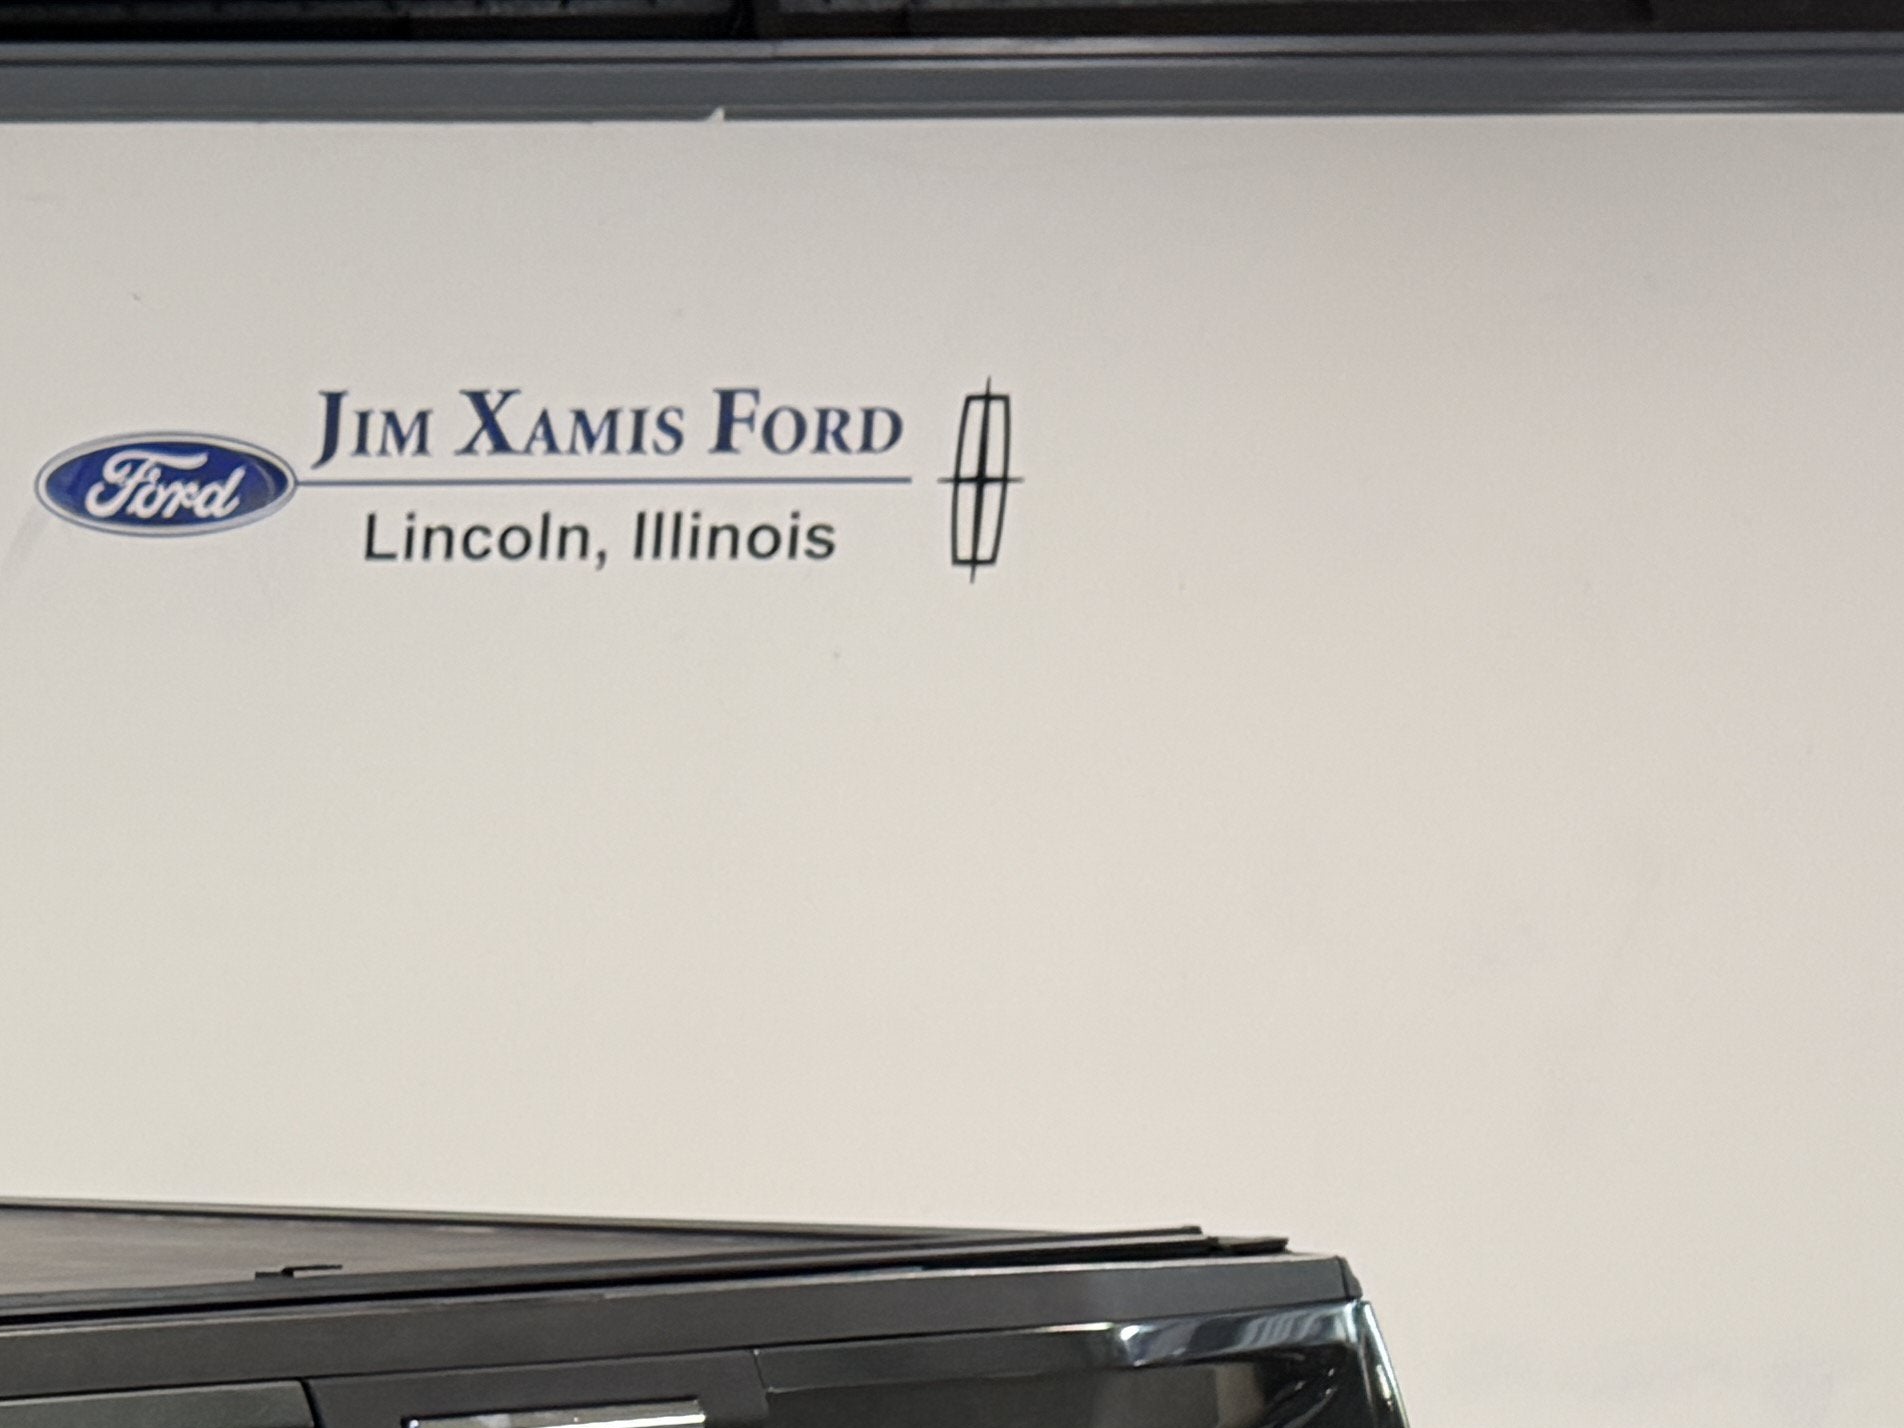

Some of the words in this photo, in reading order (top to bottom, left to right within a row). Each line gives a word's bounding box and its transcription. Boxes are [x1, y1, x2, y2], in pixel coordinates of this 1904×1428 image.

[311, 389, 432, 471] JIM
[454, 388, 685, 456] XAMIS
[709, 387, 904, 455] FORD
[85, 449, 246, 519] Ford
[363, 511, 608, 571] Lincoln,
[632, 511, 836, 561] Illinois
